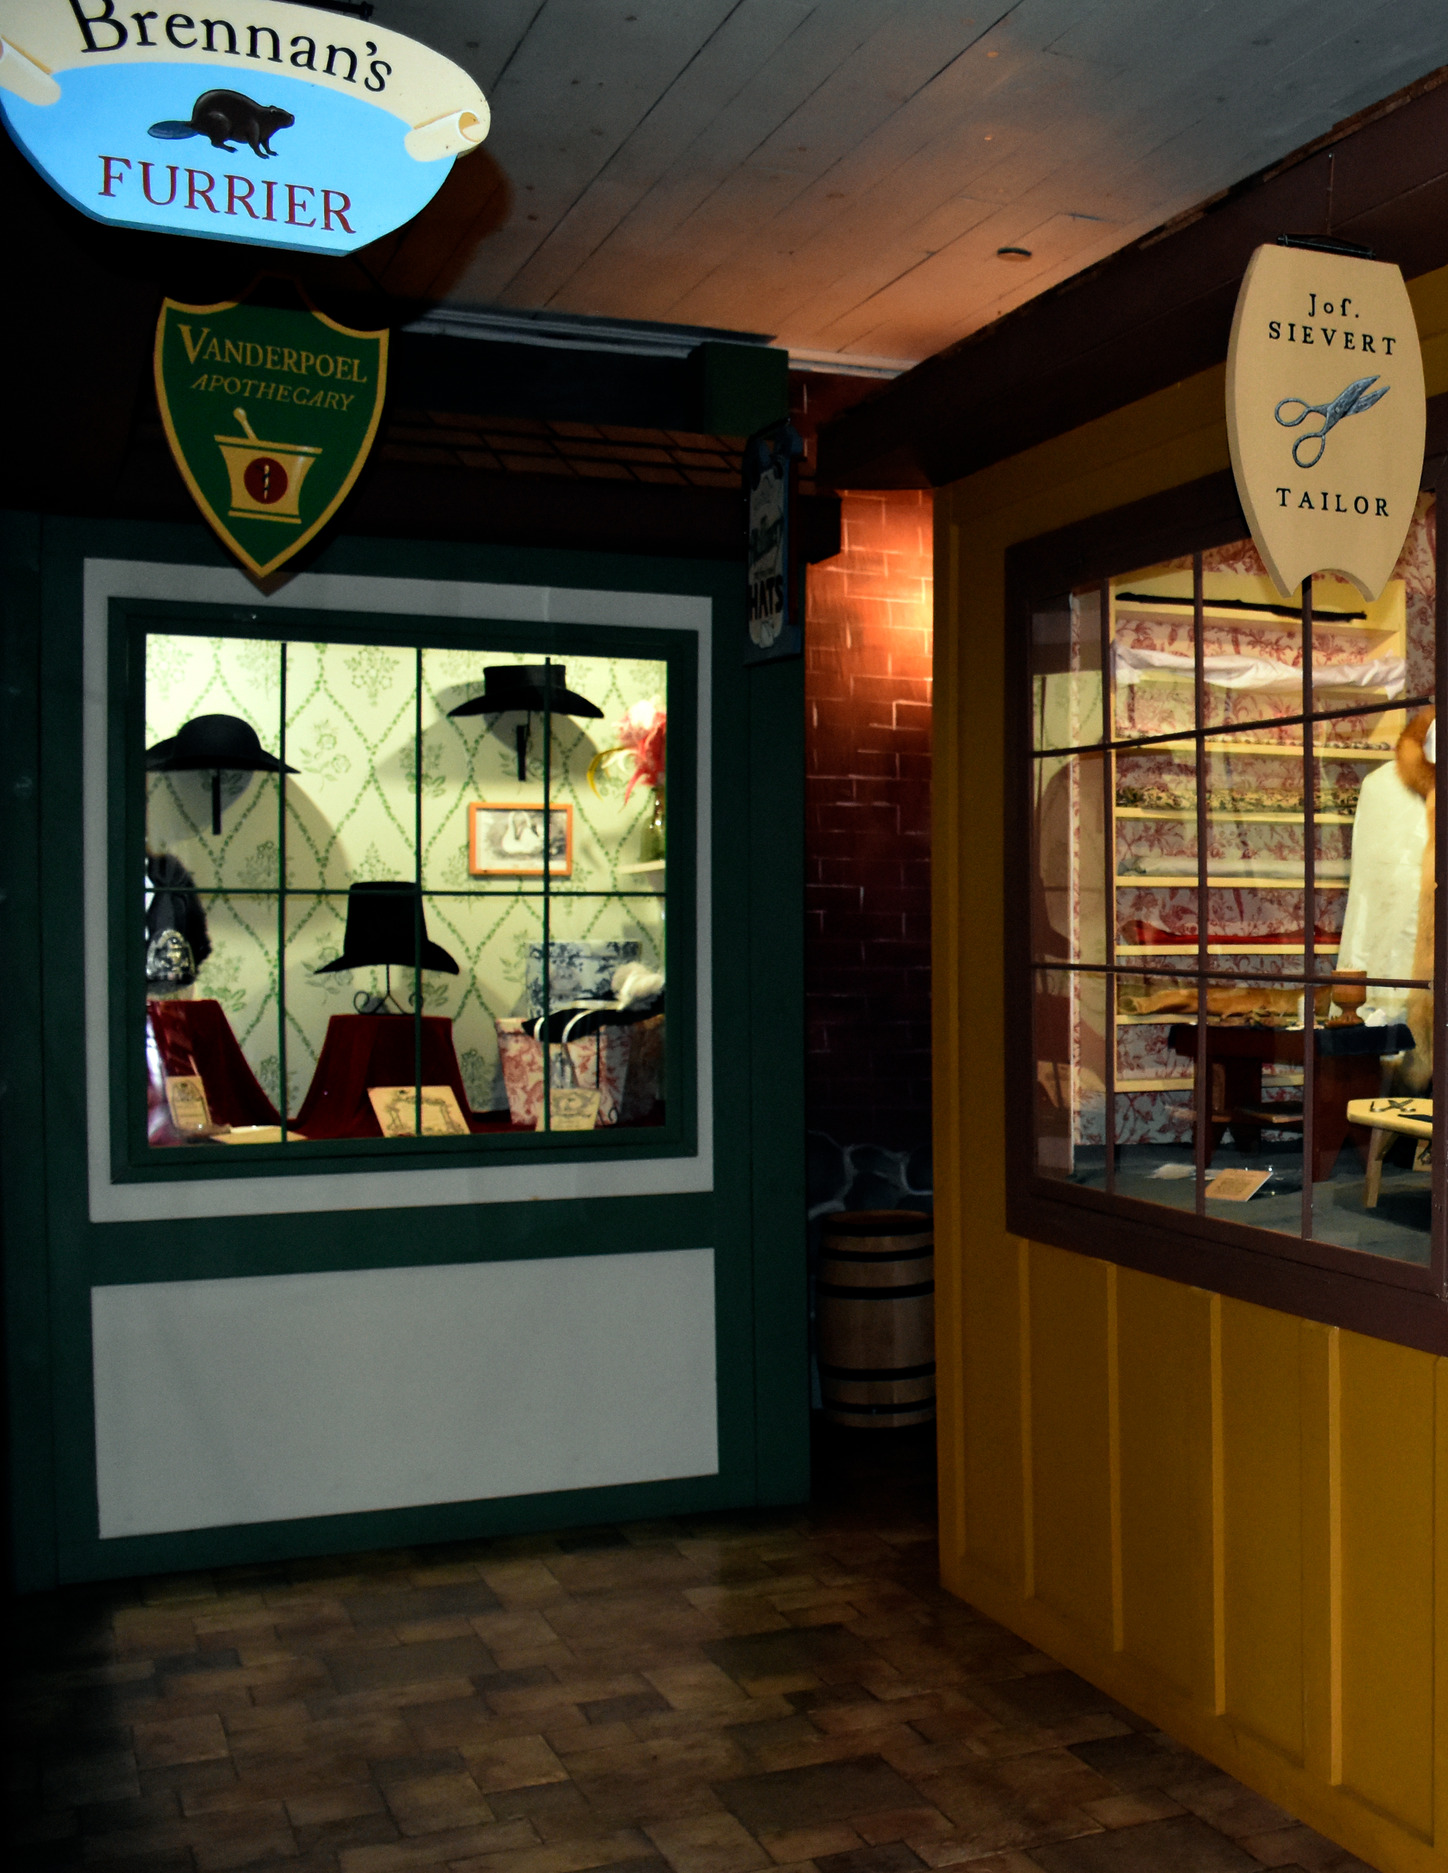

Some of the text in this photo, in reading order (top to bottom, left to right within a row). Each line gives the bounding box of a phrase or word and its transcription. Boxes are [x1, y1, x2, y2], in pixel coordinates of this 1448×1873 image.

[68, 0, 394, 92] Brennan's
[97, 154, 358, 234] FURRIER
[177, 323, 368, 383] VANDERPOEL
[1268, 320, 1397, 356] SIEVERT
[191, 373, 356, 412] APOTHECARY
[1275, 487, 1390, 517] TAILOR
[748, 574, 784, 622] HATS
